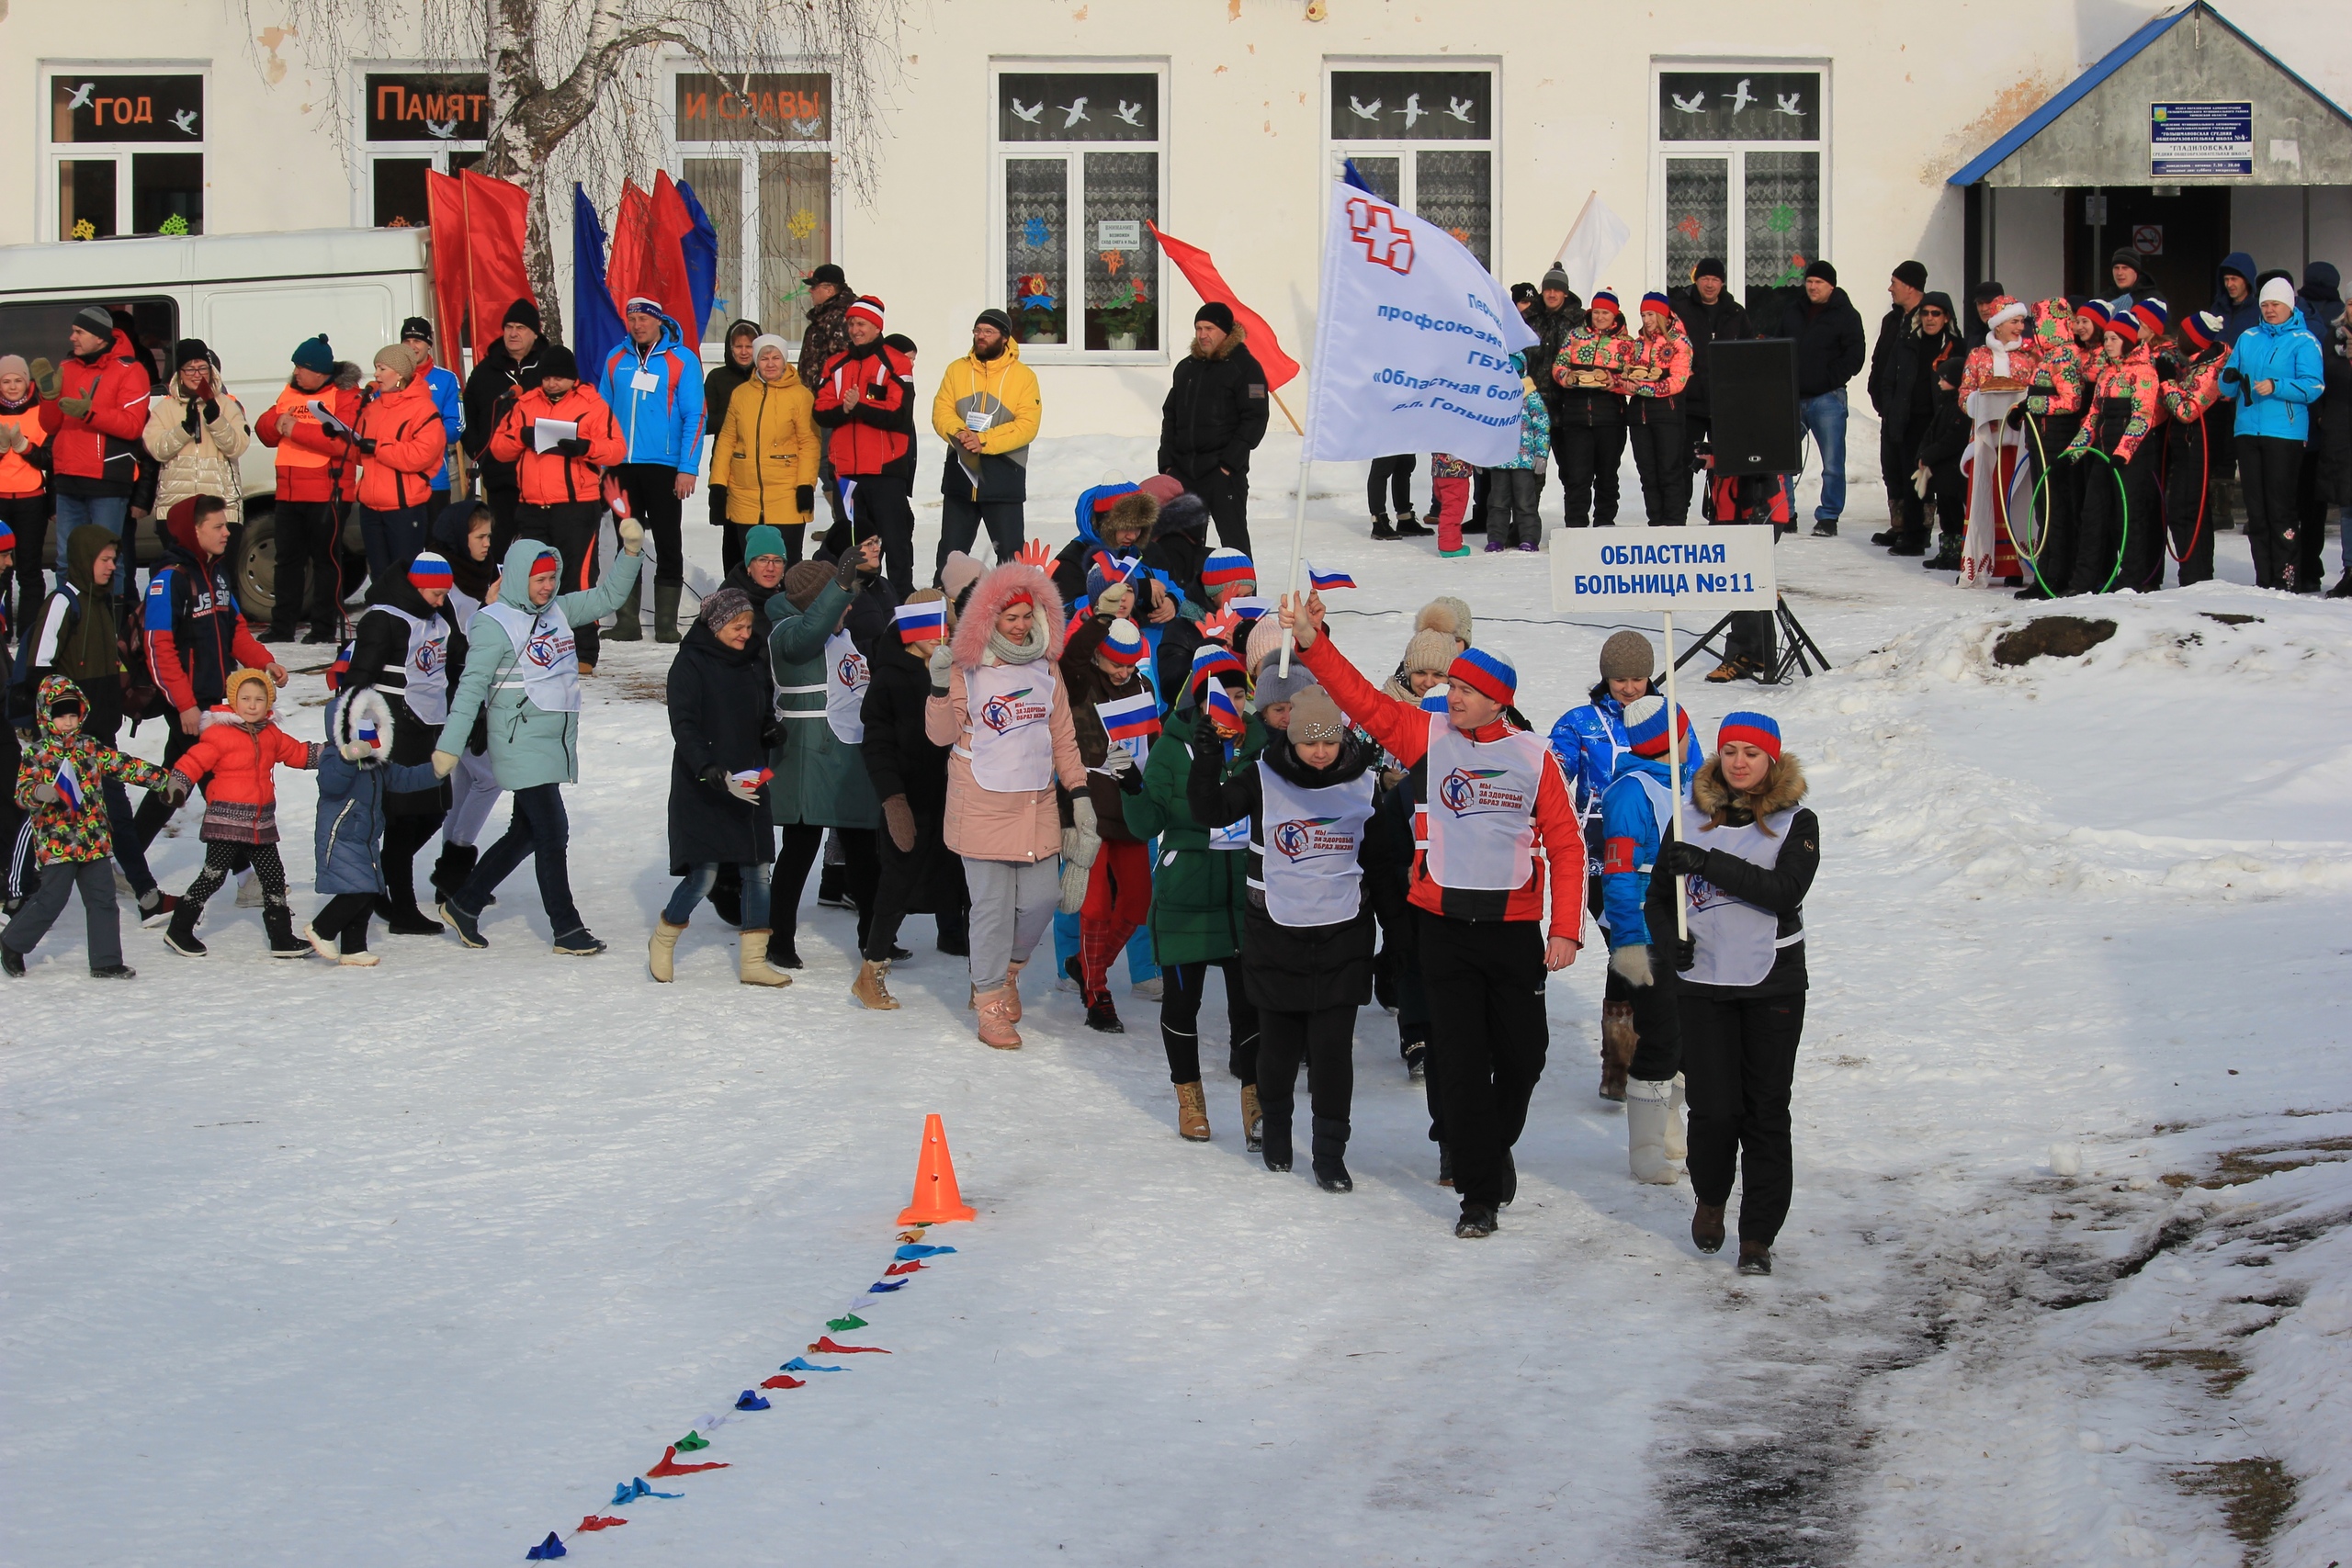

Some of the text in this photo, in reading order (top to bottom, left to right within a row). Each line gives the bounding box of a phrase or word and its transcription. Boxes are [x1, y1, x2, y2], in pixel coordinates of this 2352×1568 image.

[95, 97, 153, 126] ГОД
[378, 86, 489, 122] ПАМЯТ
[686, 92, 707, 119] И
[1373, 367, 1481, 395] «Областная
[1601, 544, 1725, 565] ОБЛАСТНАЯ
[1574, 573, 1754, 596] БОЛЬНИЦА №11
[1479, 798, 1522, 809] ОБРАЗ ЖИЗНИ
[1488, 791, 1523, 802] ЗДОРОВЫЙ
